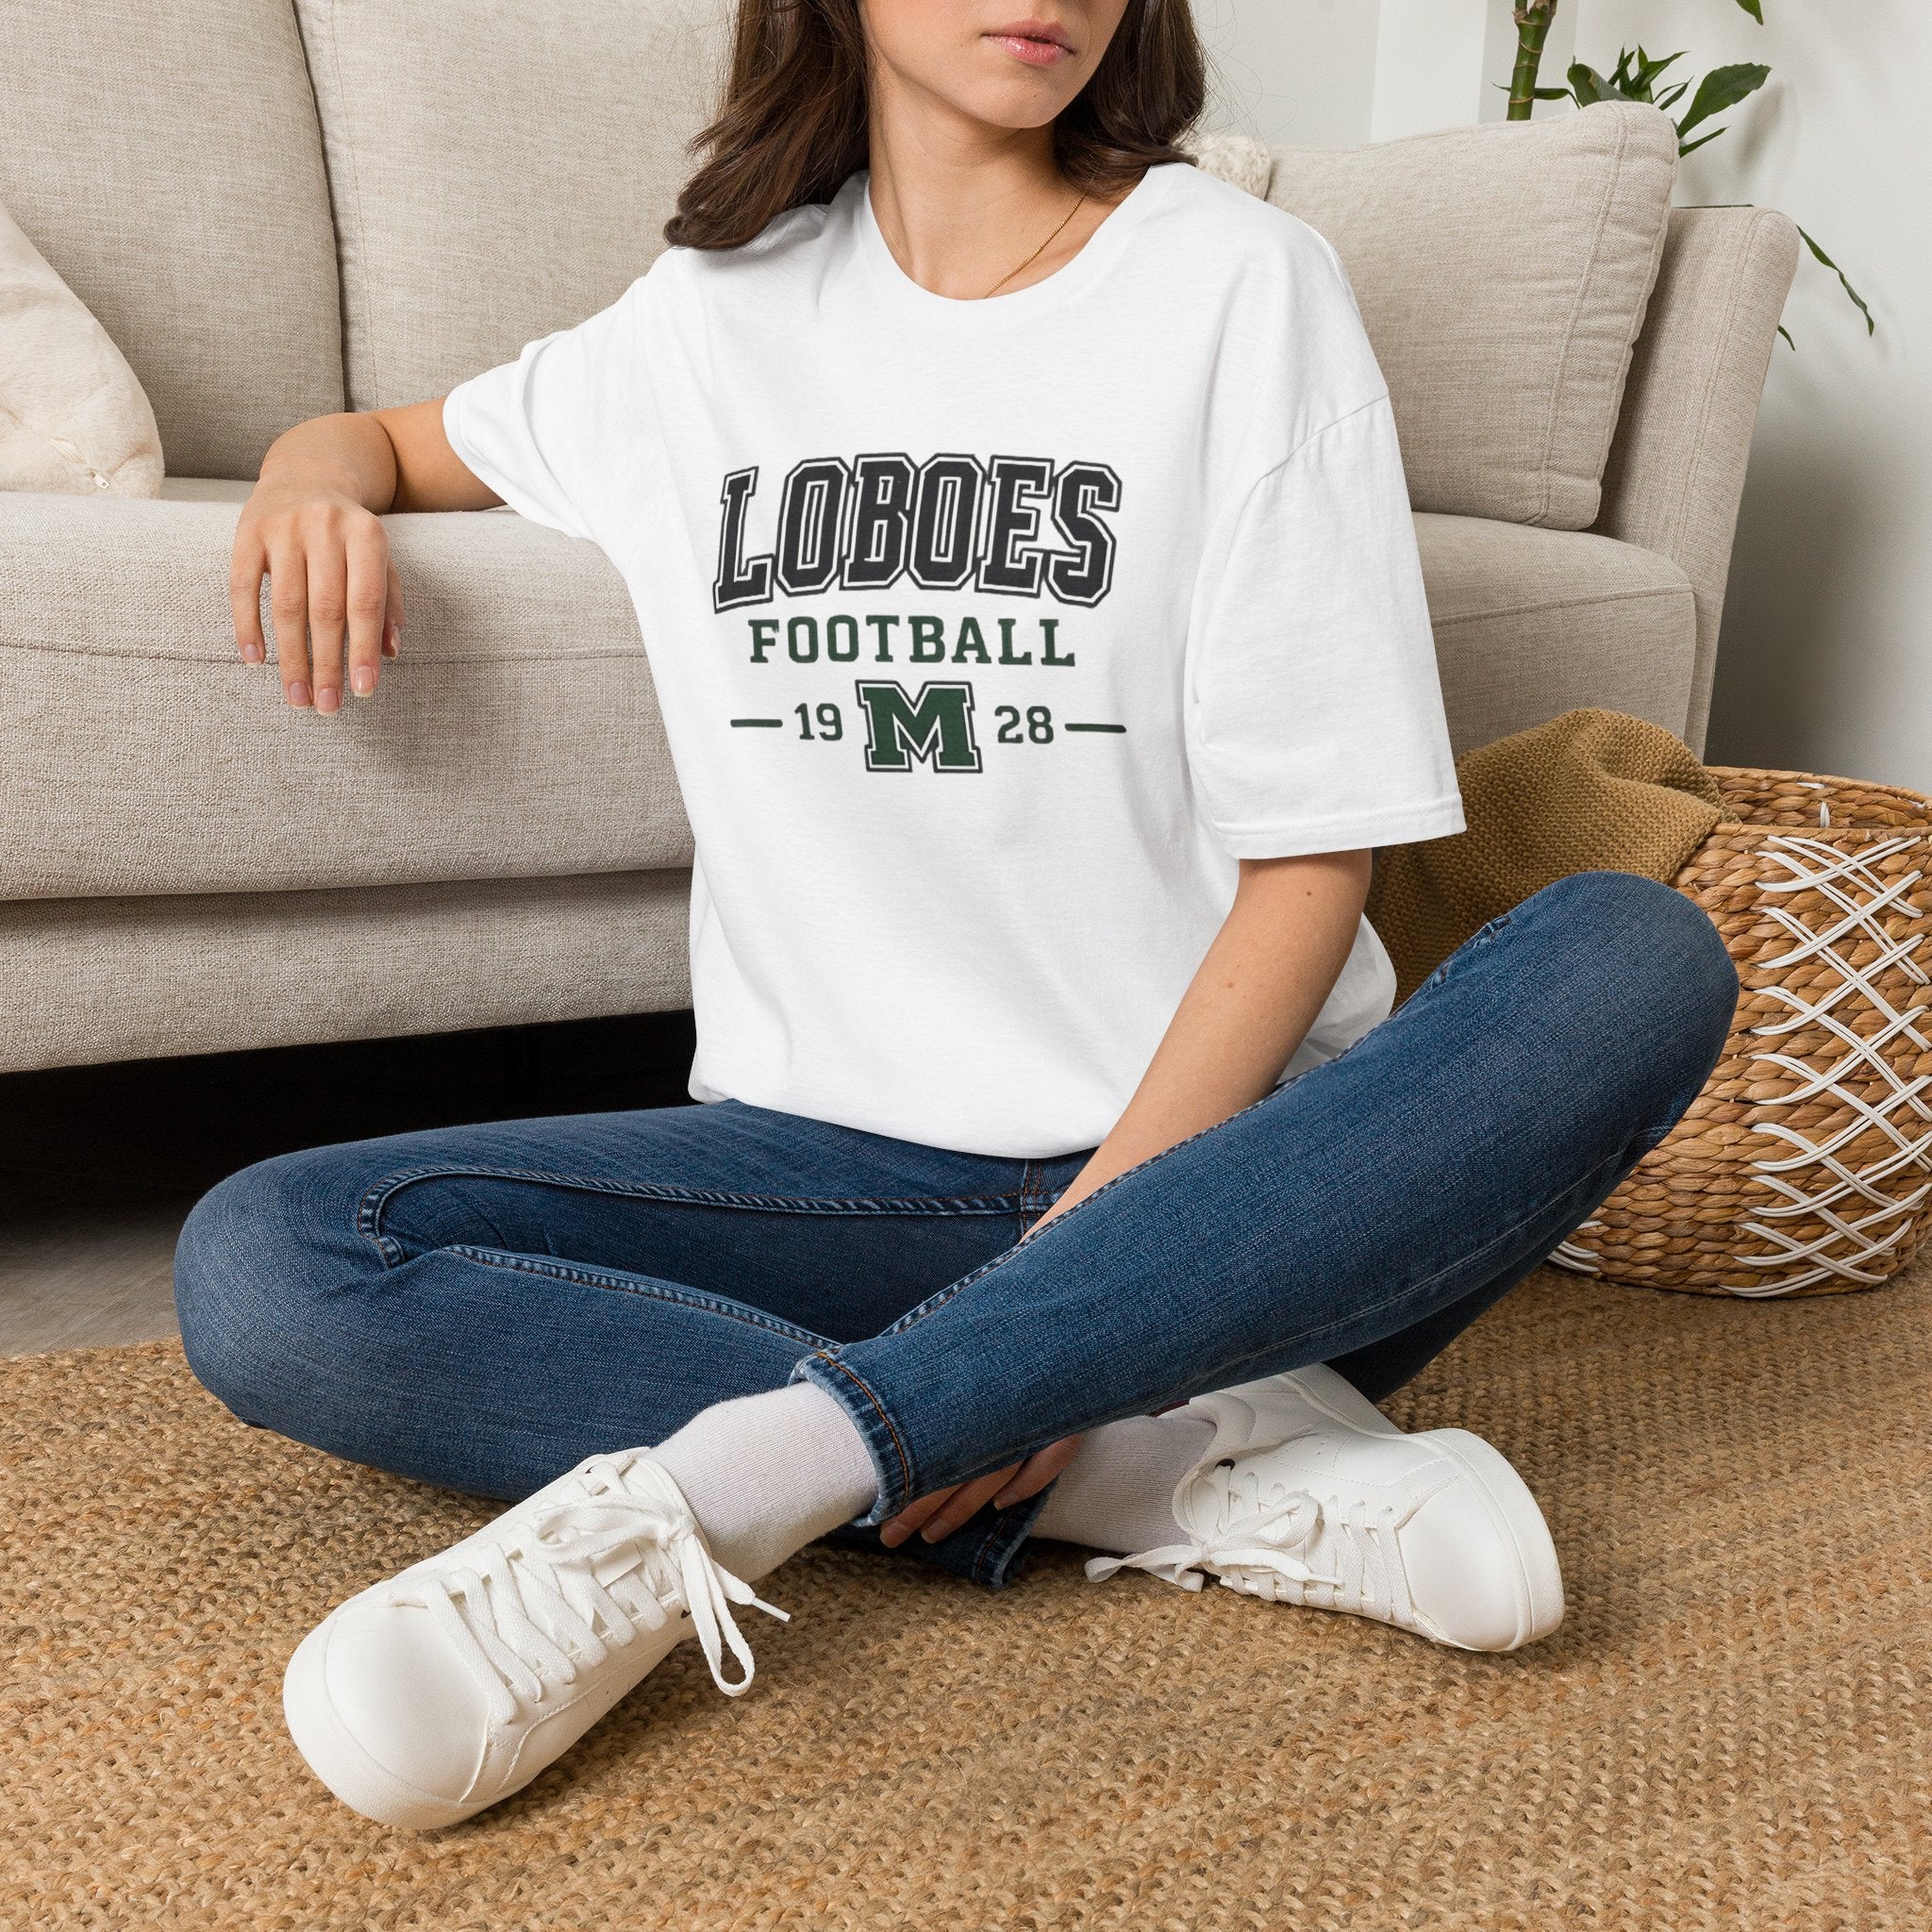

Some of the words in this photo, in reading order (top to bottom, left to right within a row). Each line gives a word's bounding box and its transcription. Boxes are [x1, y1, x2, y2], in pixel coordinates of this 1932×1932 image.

[713, 453, 1123, 614] LOBOES
[747, 614, 1075, 667] FOOTBALL
[794, 703, 843, 741] 19
[855, 679, 983, 774] M
[994, 705, 1055, 744] 28
